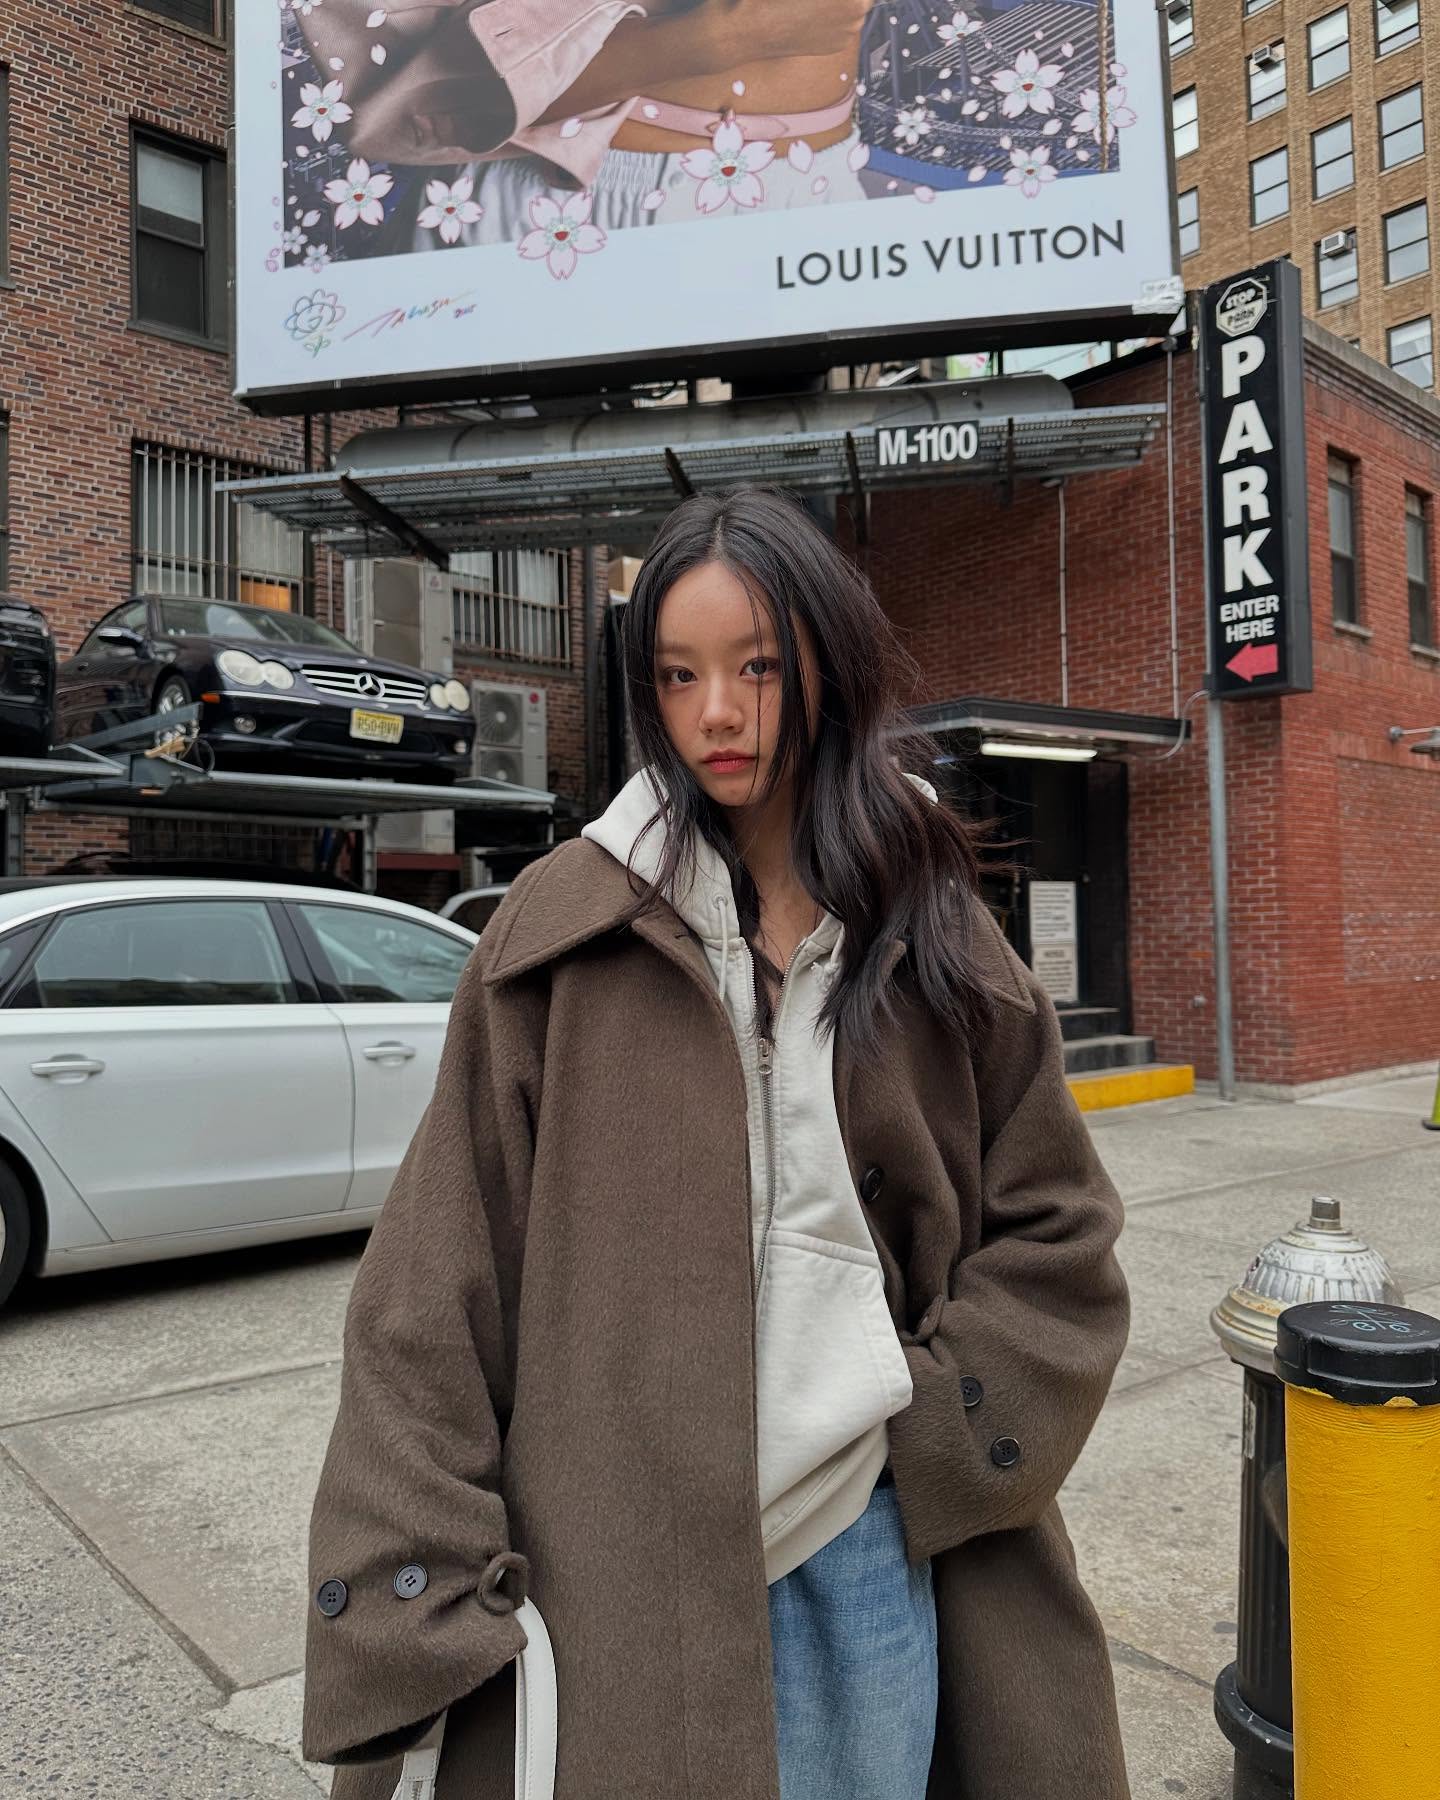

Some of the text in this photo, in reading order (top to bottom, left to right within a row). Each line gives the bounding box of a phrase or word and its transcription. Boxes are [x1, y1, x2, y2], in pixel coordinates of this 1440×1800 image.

[777, 219, 1125, 290] LOUIS VUITTON
[1225, 287, 1257, 310] STOP
[1227, 306, 1257, 327] PARK
[879, 422, 978, 466] M-1100
[1218, 335, 1275, 593] PARK
[1220, 594, 1280, 623] ENTER
[1225, 617, 1276, 643] HERE
